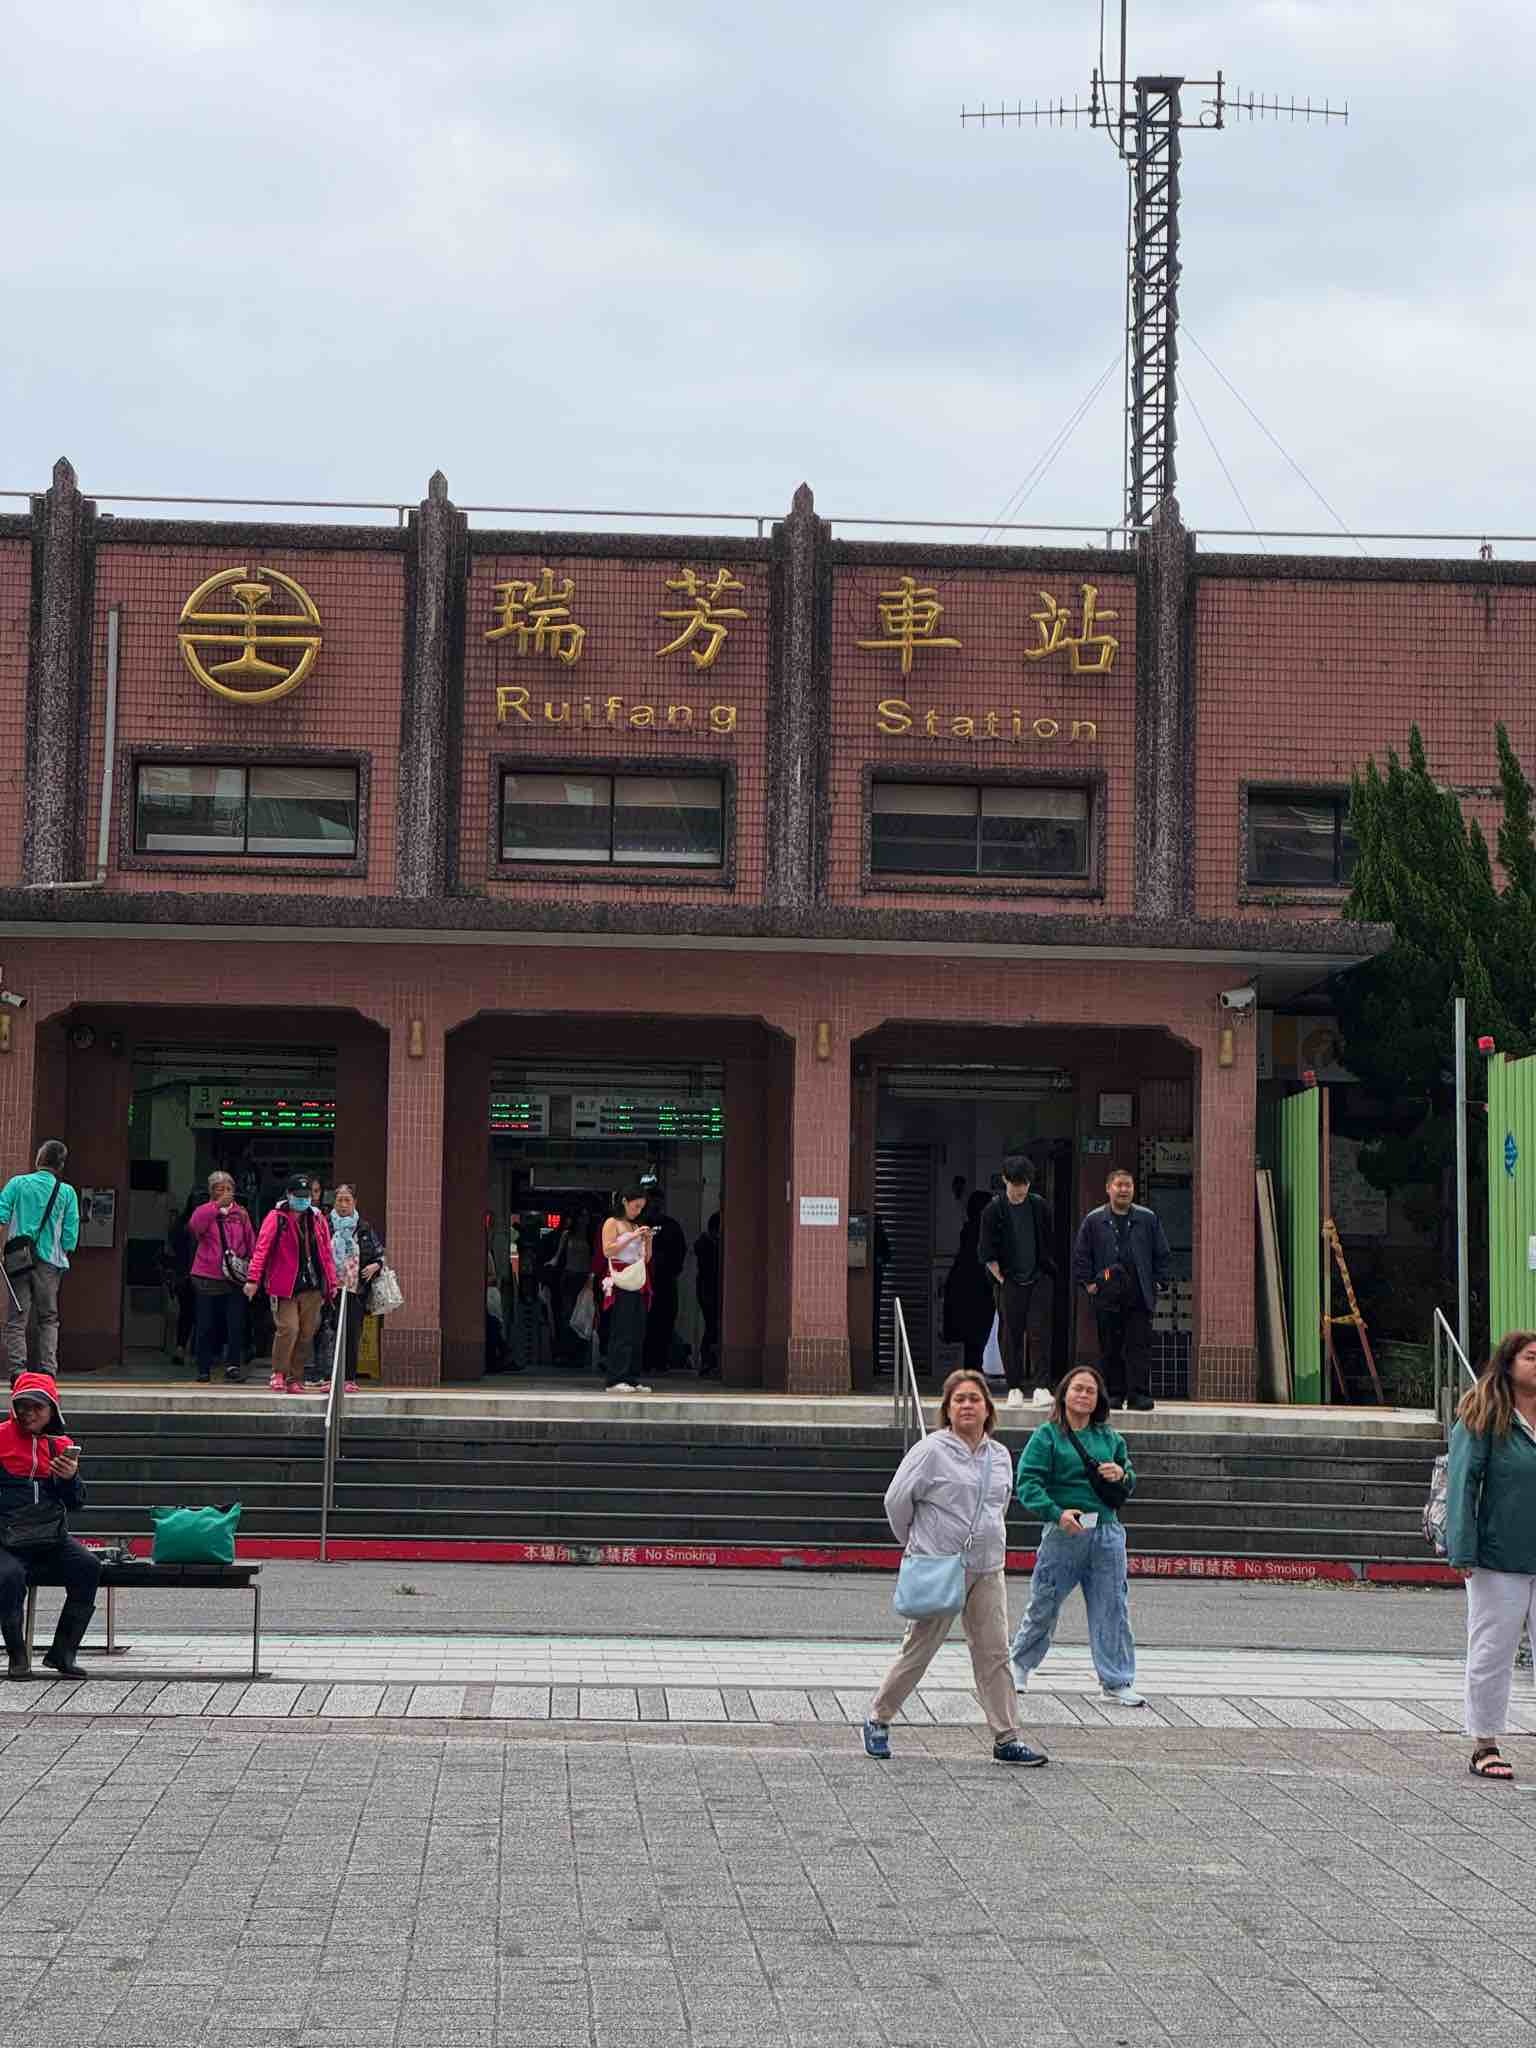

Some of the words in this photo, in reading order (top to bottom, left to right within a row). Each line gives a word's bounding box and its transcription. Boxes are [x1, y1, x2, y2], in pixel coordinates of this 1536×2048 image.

[495, 686, 738, 734] Ruifang
[876, 699, 1098, 741] Station
[524, 1544, 637, 1563] 本場所禁菸
[645, 1548, 662, 1561] No
[665, 1548, 717, 1564] Smoking
[1244, 1561, 1262, 1574] No
[1265, 1561, 1316, 1577] Smoking
